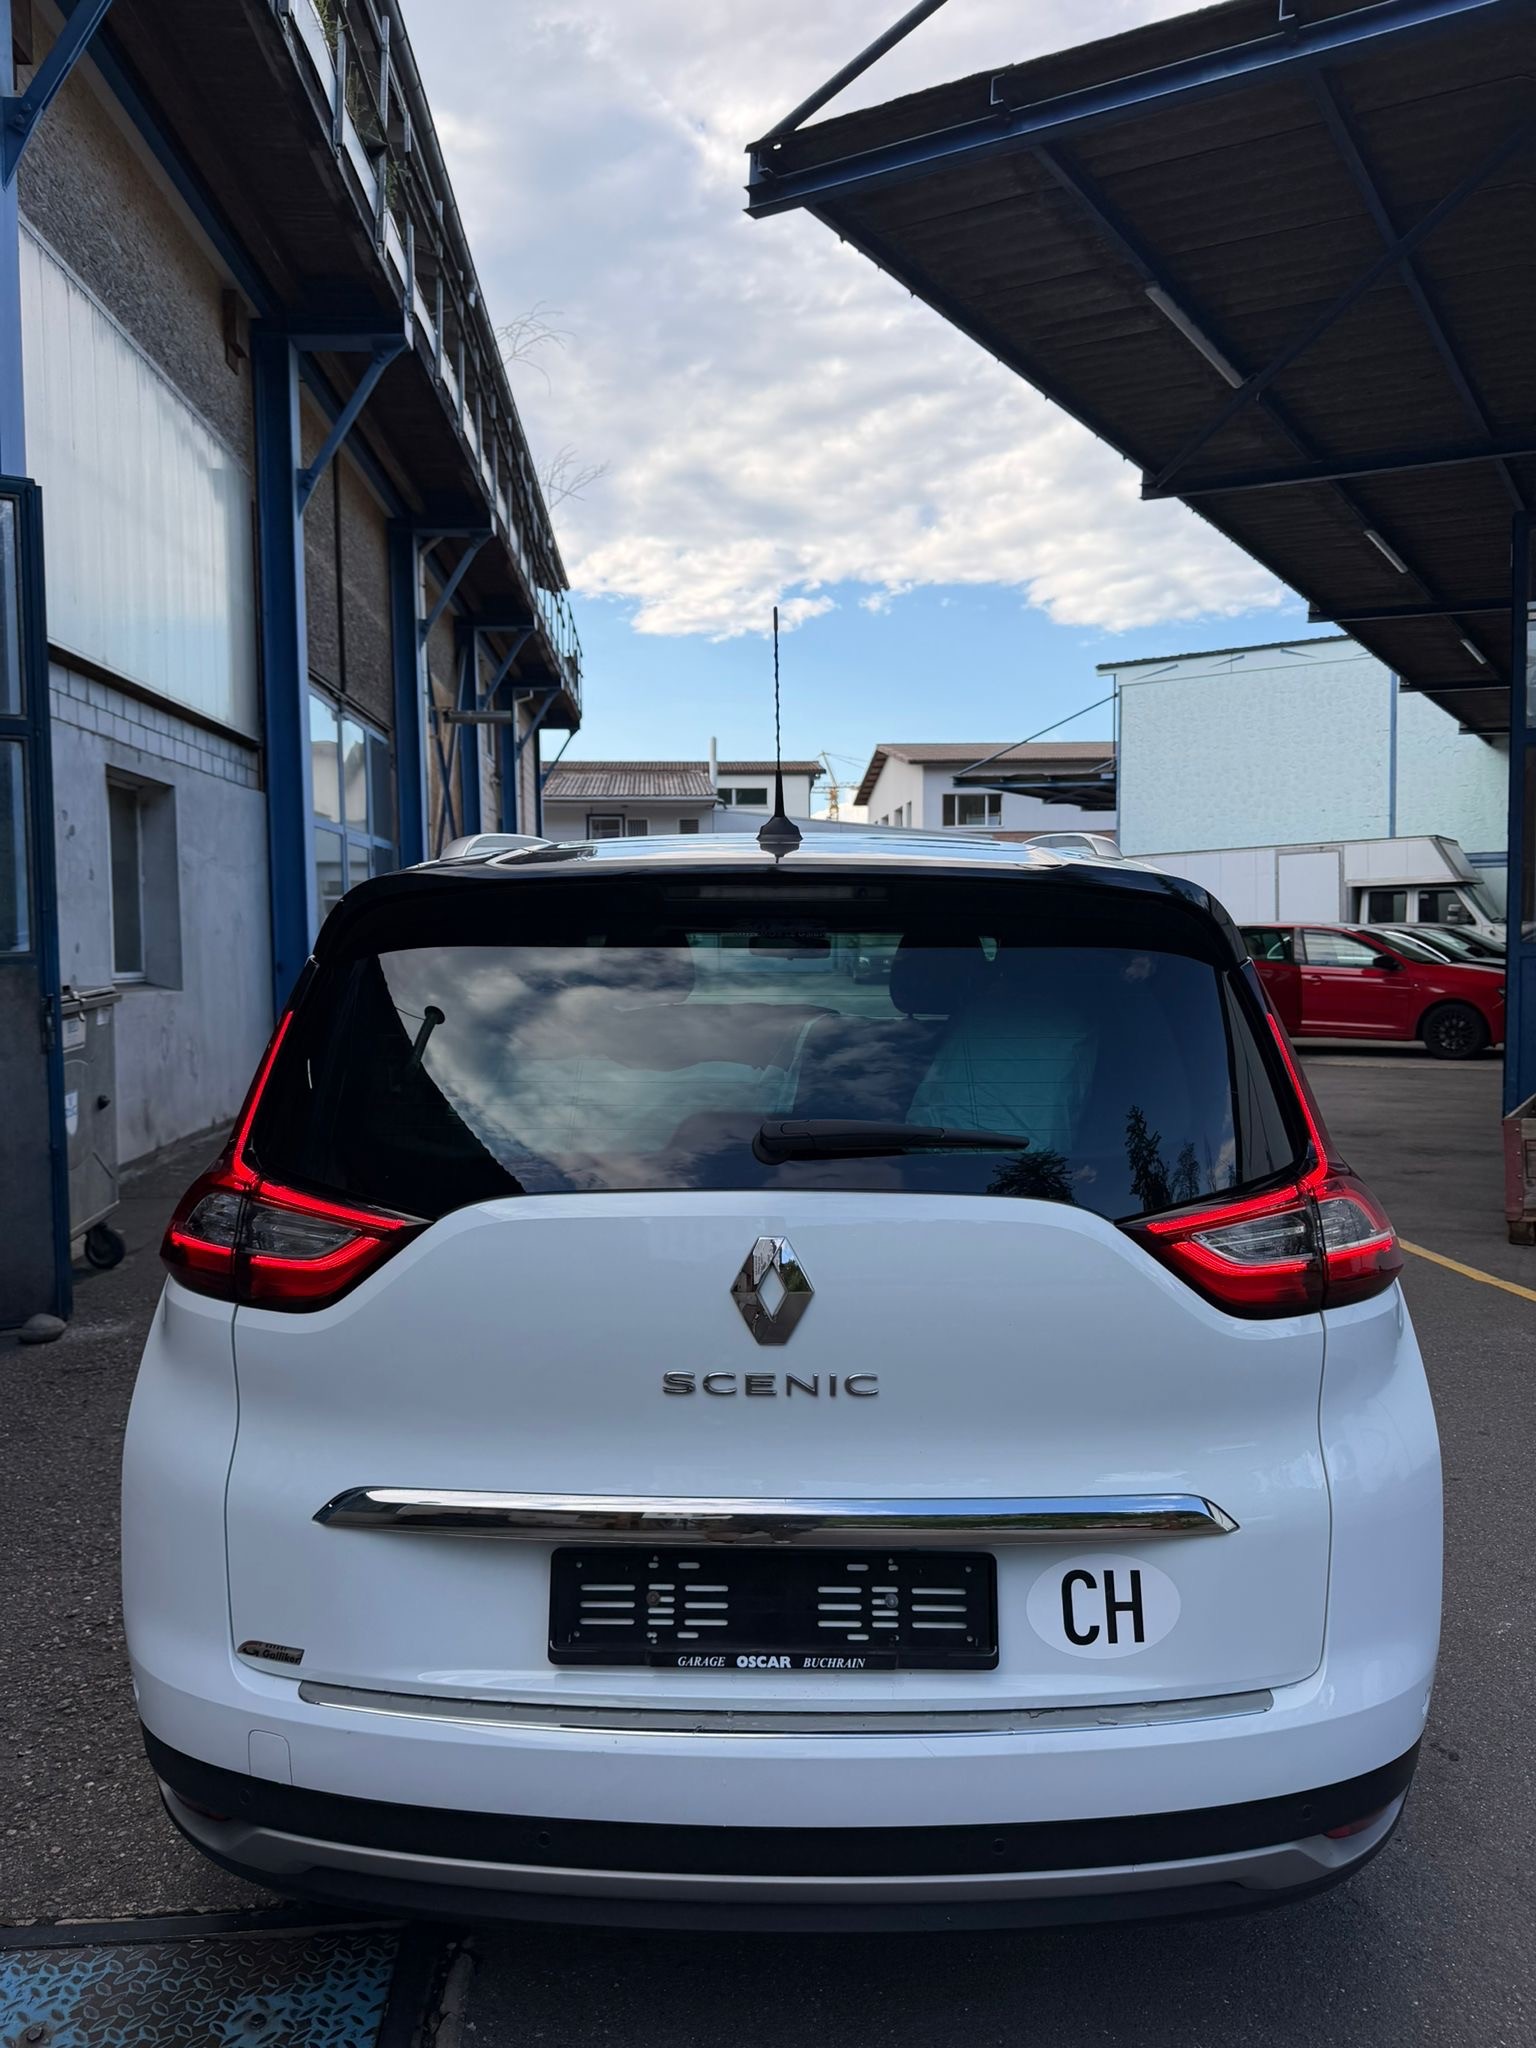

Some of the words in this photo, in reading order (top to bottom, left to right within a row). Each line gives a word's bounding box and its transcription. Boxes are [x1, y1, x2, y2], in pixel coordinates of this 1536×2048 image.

[662, 1370, 879, 1397] SCENIC
[1061, 1569, 1145, 1646] CH
[677, 1656, 726, 1668] GARAGE
[736, 1655, 792, 1669] OSCAR
[802, 1657, 866, 1670] BUCHRAIN
